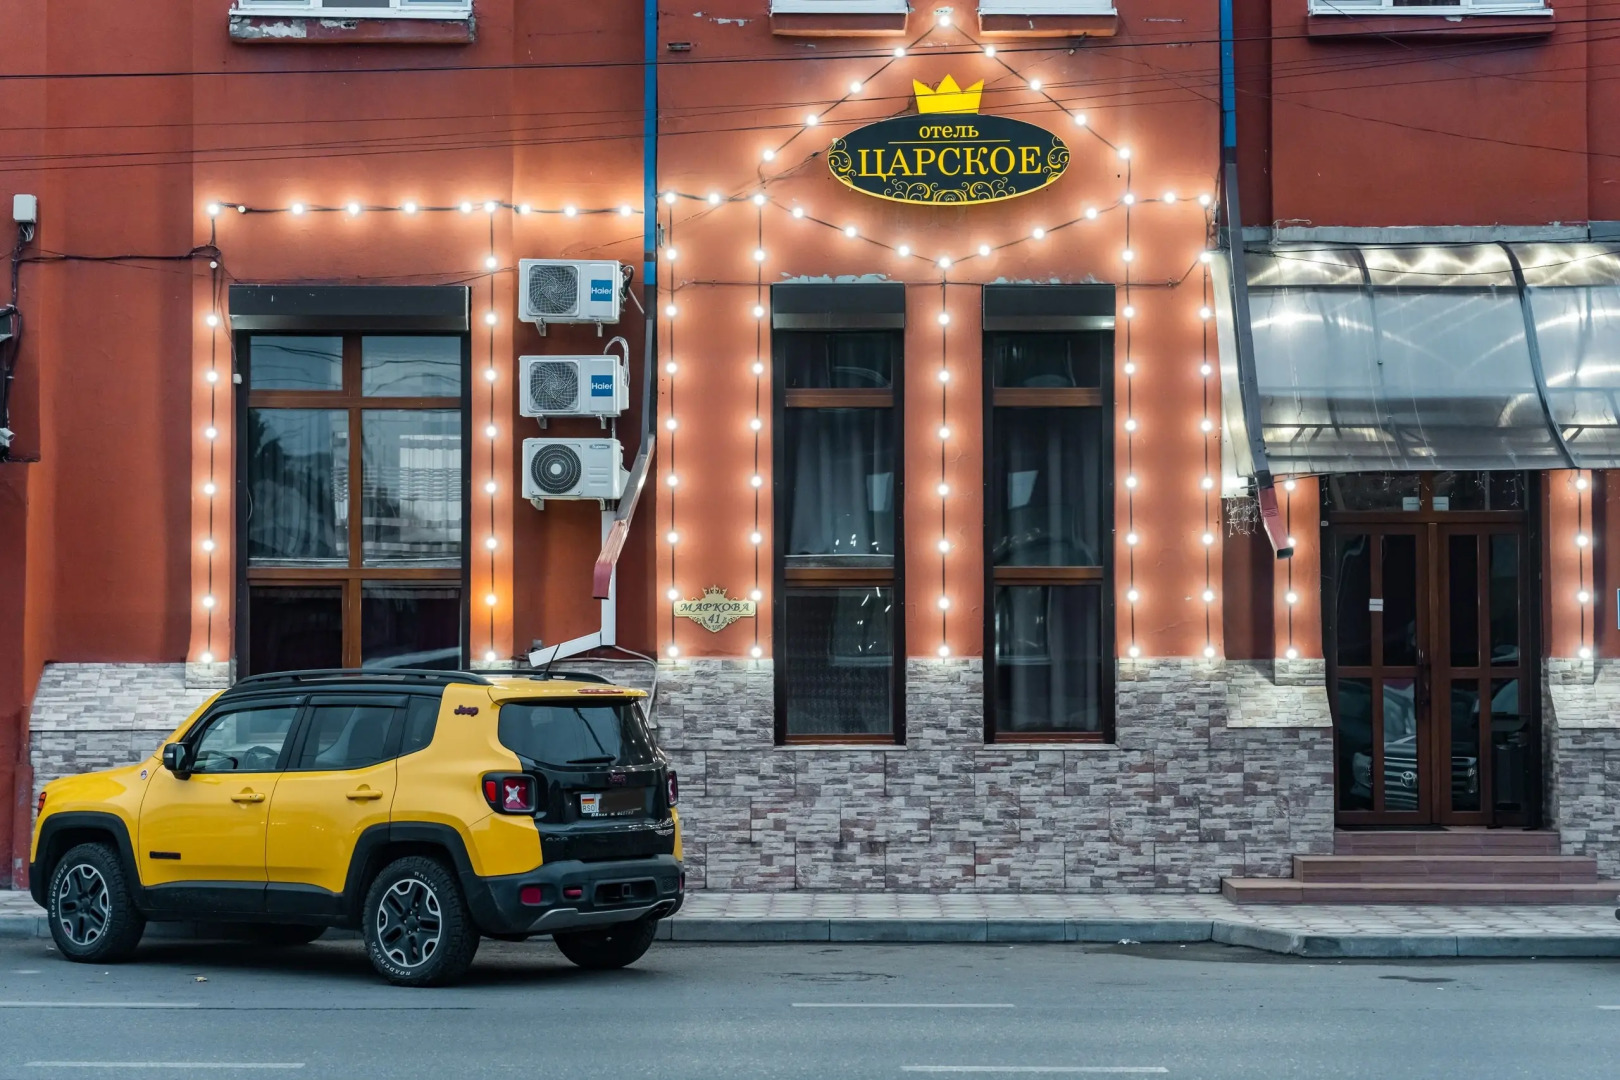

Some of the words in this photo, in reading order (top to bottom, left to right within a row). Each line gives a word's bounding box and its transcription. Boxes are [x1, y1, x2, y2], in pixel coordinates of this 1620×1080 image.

[919, 125, 979, 138] отель
[858, 146, 1042, 182] ЦАРСКОЕ
[591, 286, 612, 295] Haier
[591, 382, 613, 390] Haier
[680, 602, 750, 613] МАРКОВА
[708, 614, 720, 624] 41
[454, 704, 479, 717] Jeep
